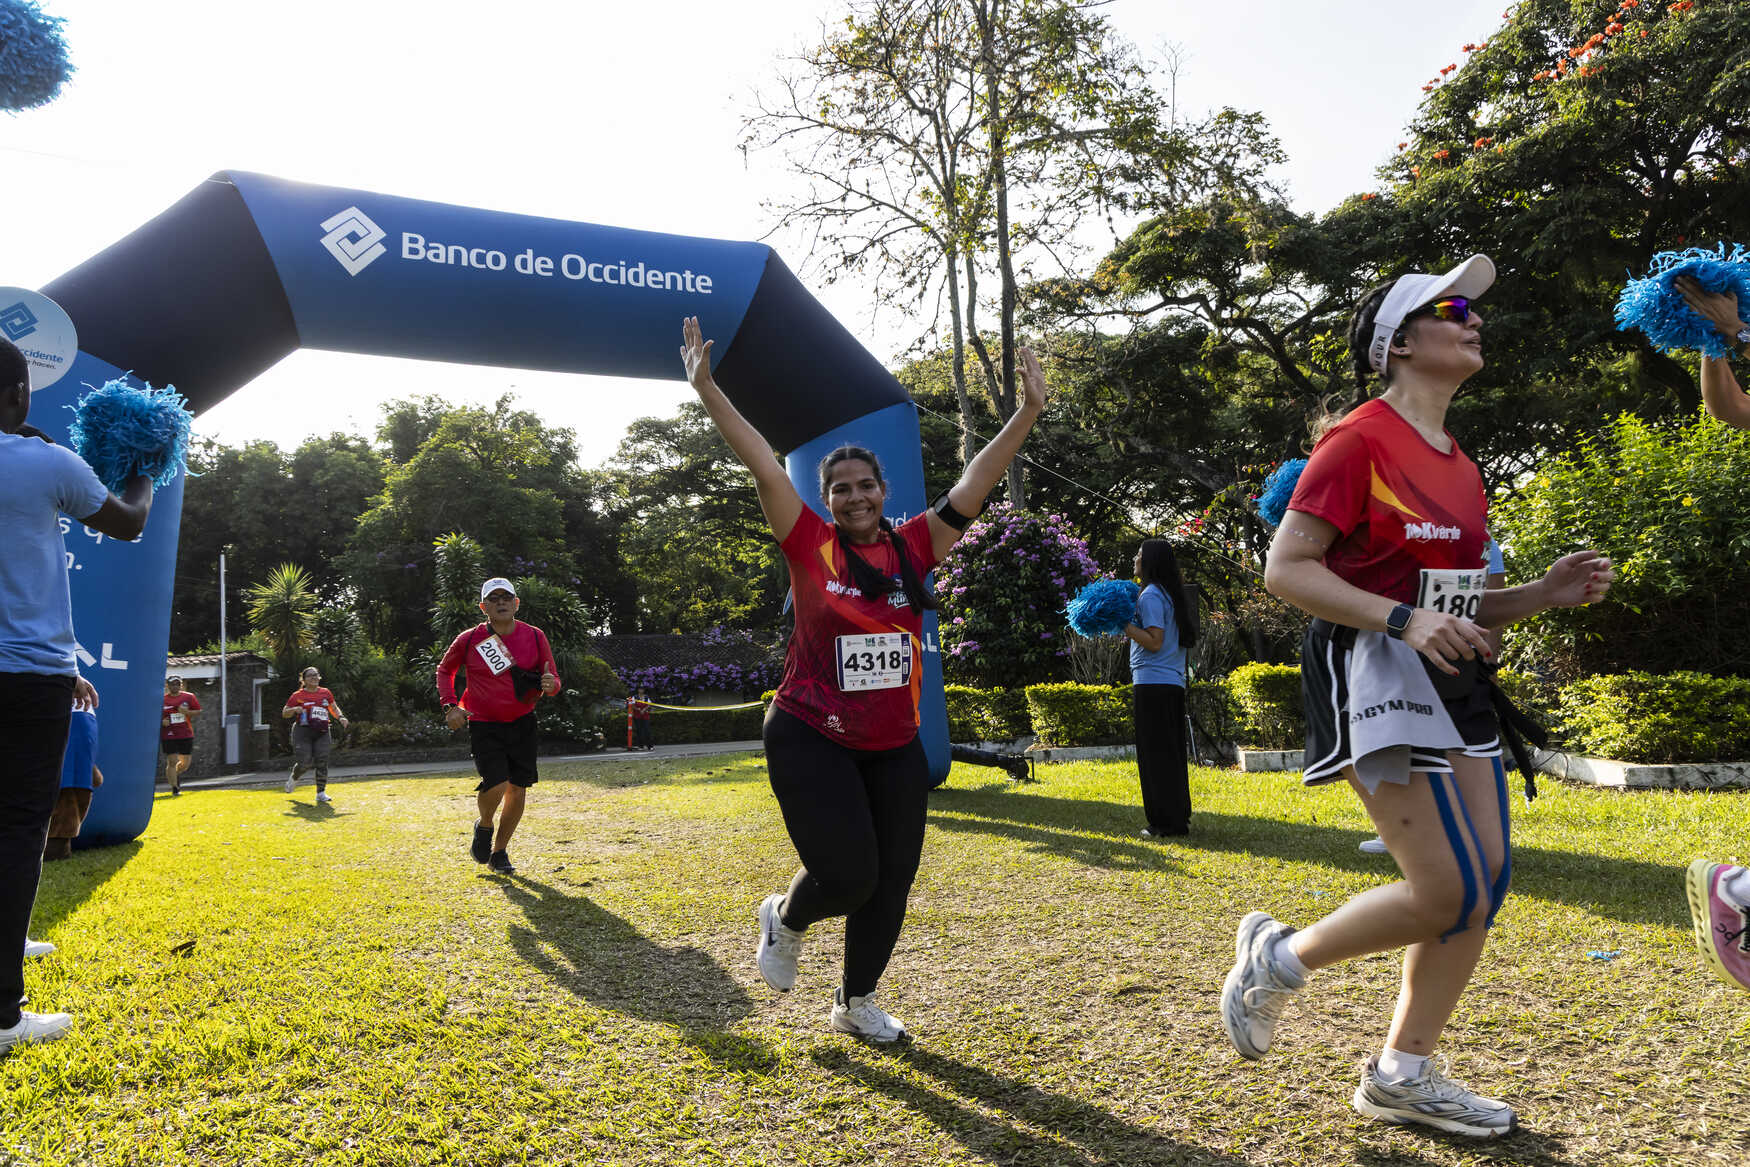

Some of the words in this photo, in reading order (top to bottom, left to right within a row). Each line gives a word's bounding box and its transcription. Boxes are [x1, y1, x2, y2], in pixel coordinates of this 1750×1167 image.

[401, 231, 506, 271] Banco
[514, 249, 553, 277] de
[561, 253, 713, 294] Occidente
[480, 642, 506, 671] 2000
[844, 650, 901, 672] 4318
[1364, 699, 1405, 719] GYM
[1407, 701, 1434, 717] PRO
